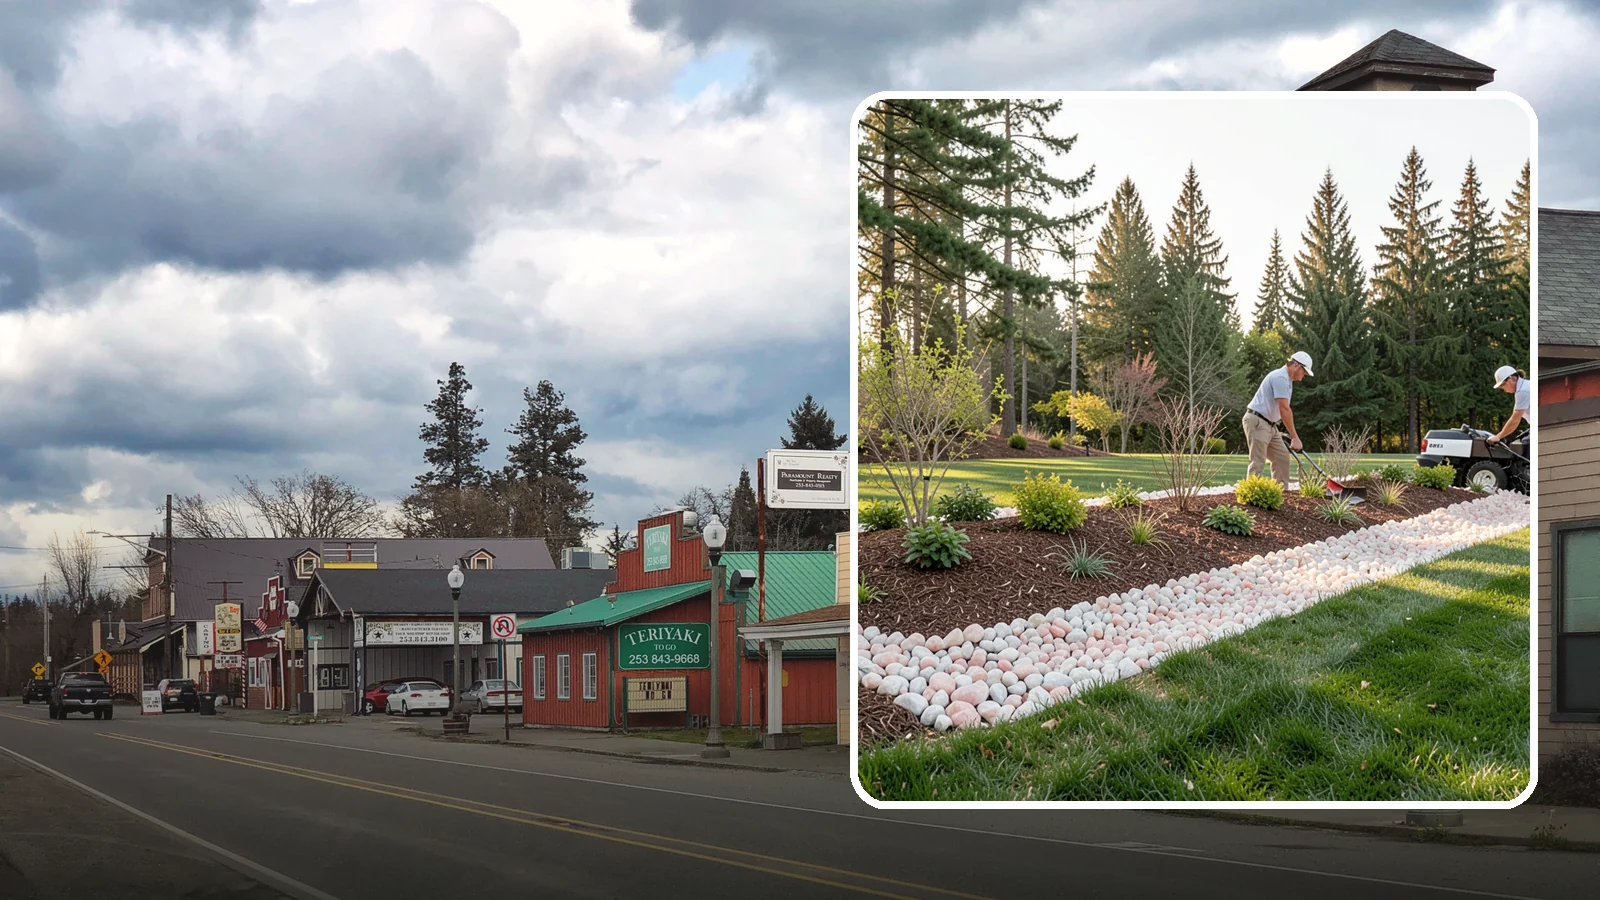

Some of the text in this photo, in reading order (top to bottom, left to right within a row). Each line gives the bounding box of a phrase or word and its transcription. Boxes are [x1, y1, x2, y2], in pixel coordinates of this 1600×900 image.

[625, 628, 702, 646] TERIYAKI
[629, 654, 700, 664] 253 843-9668
[639, 681, 672, 690] TERIYAKI
